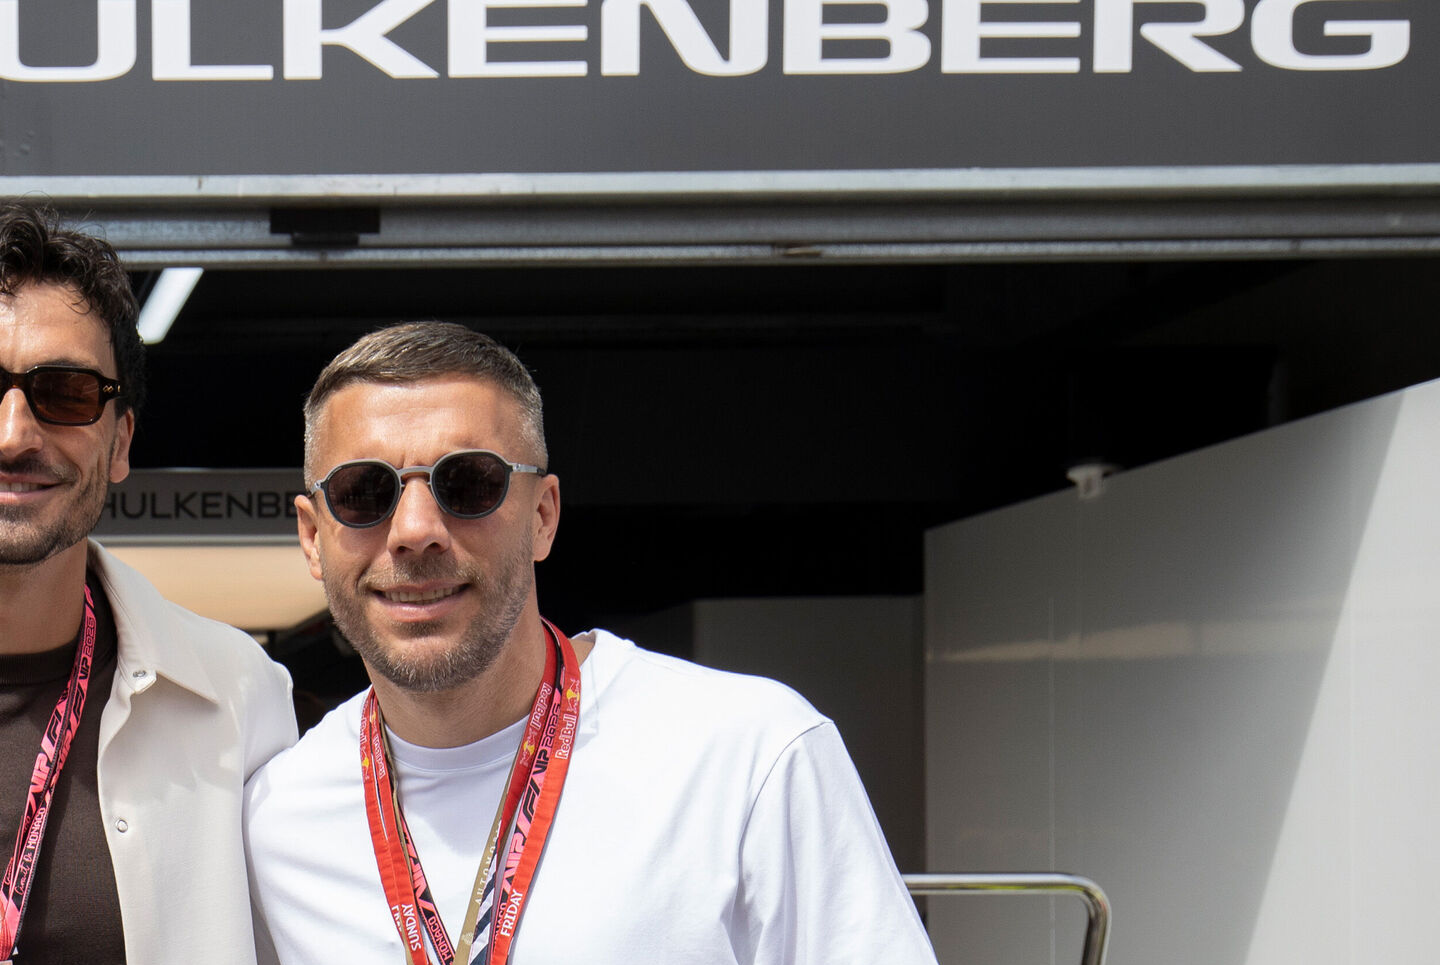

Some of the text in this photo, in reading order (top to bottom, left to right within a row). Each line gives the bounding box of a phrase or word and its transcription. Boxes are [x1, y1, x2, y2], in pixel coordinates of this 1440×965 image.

[26, 807, 47, 849] MONACO
[401, 904, 422, 952] SUNDAY
[500, 889, 524, 937] FRIDAY
[428, 915, 453, 961] MONACO
